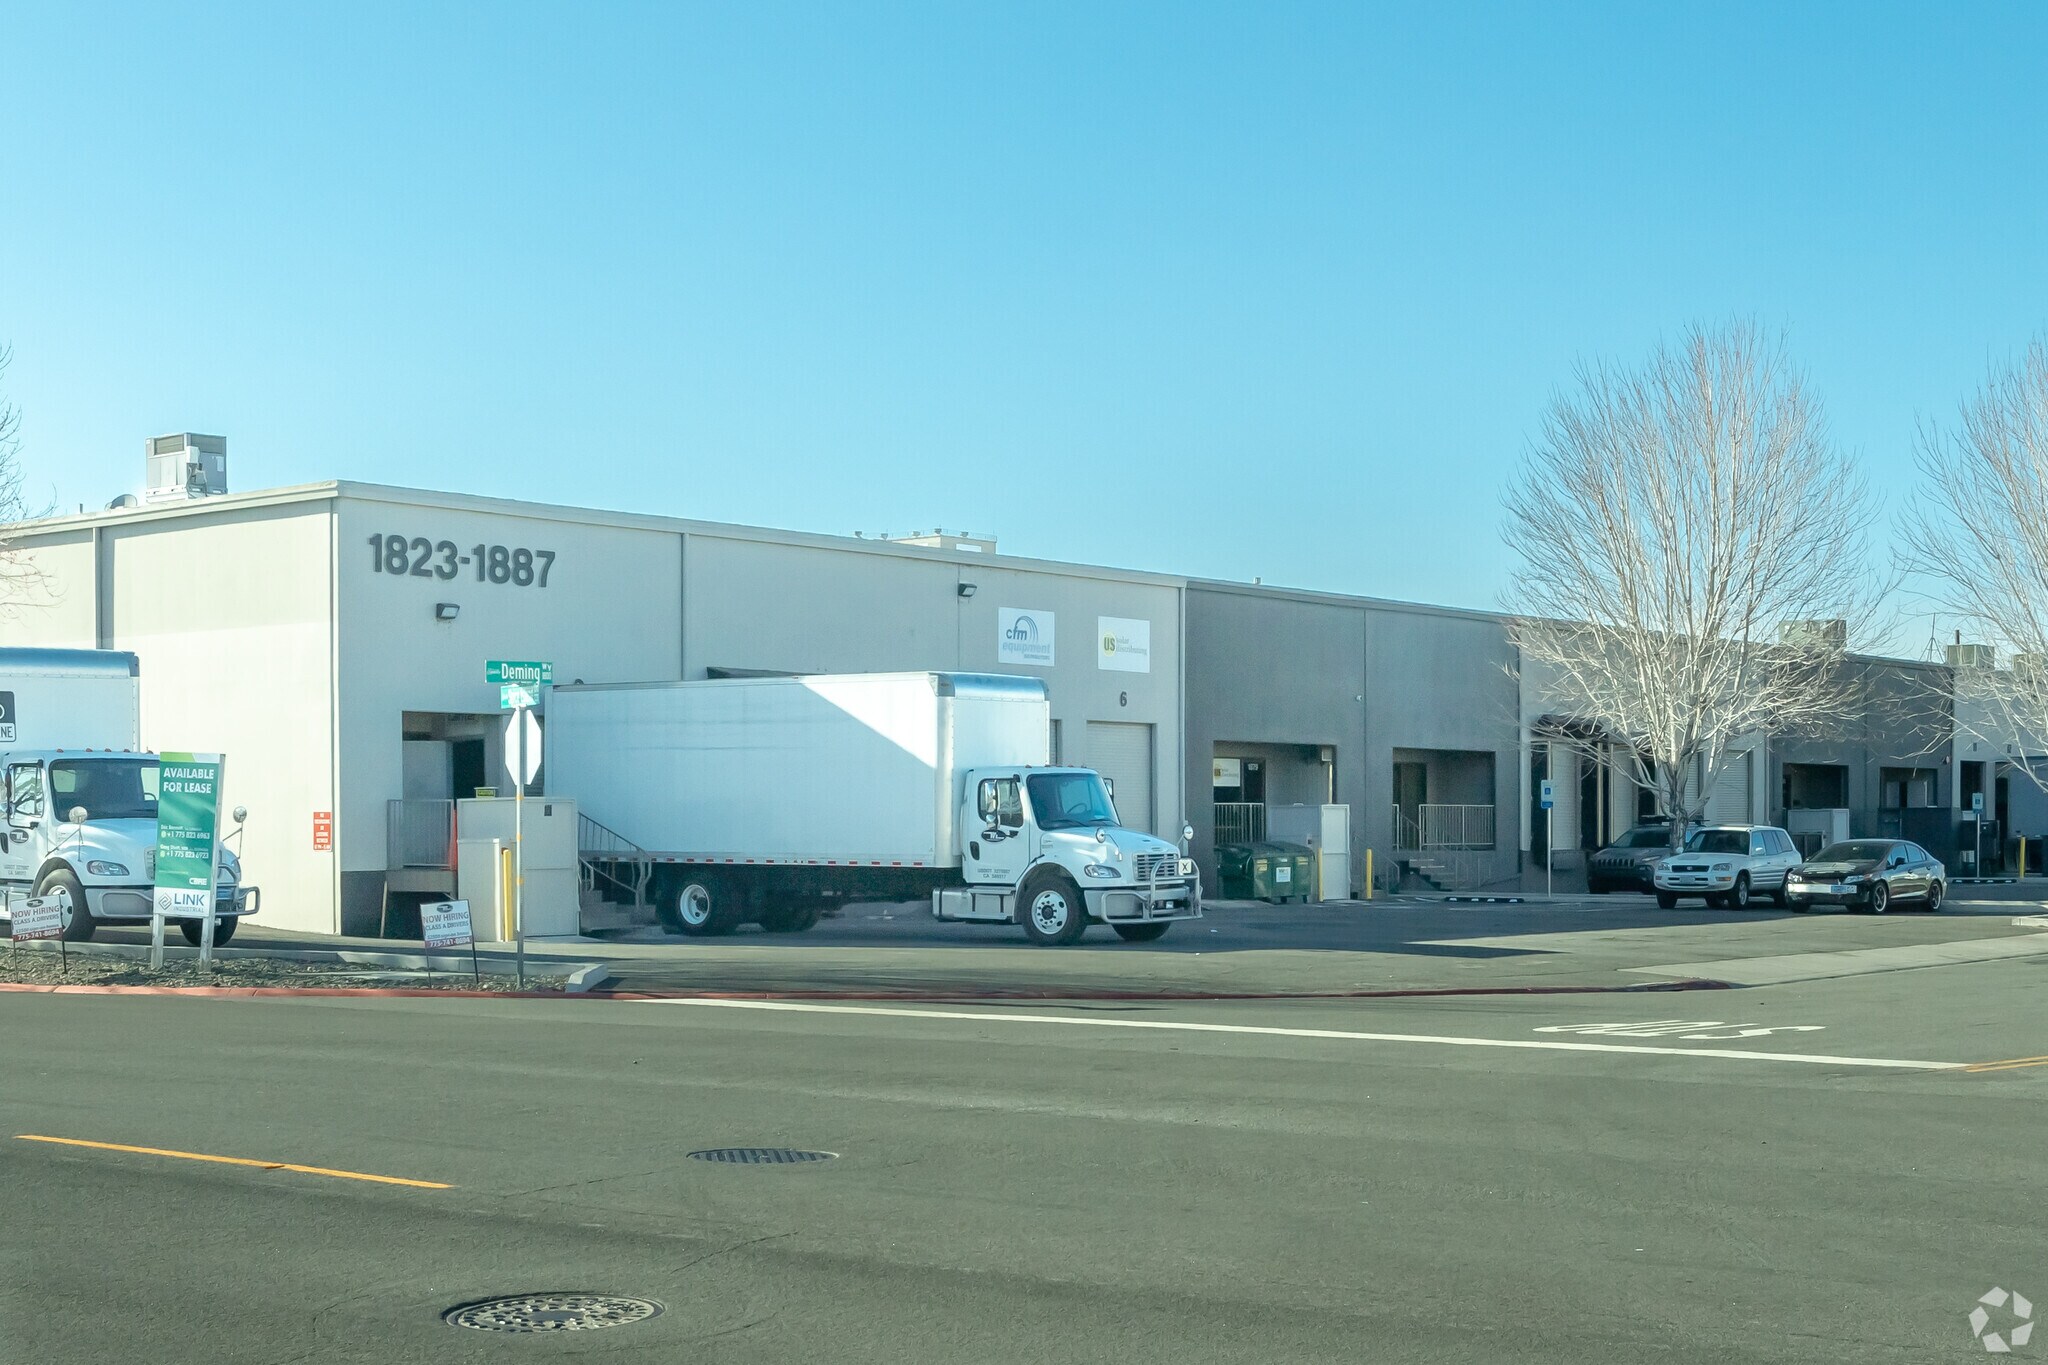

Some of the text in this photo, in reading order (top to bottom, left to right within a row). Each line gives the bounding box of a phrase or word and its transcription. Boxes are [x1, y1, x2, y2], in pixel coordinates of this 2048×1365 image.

[368, 533, 556, 588] 1823-1887
[1006, 625, 1028, 641] cfm
[1003, 642, 1051, 654] equipment
[1104, 637, 1116, 651] US
[501, 663, 540, 686] Deming
[1119, 691, 1128, 707] 6
[0, 726, 13, 738] NE
[163, 768, 215, 780] AVAILABLE
[163, 782, 212, 794] FOR LEASE
[1182, 863, 1189, 871] X
[174, 893, 205, 906] LINK
[12, 905, 60, 918] NOW HIRING
[37, 914, 60, 922] DRIVERS
[422, 911, 469, 924] NOW HIRING
